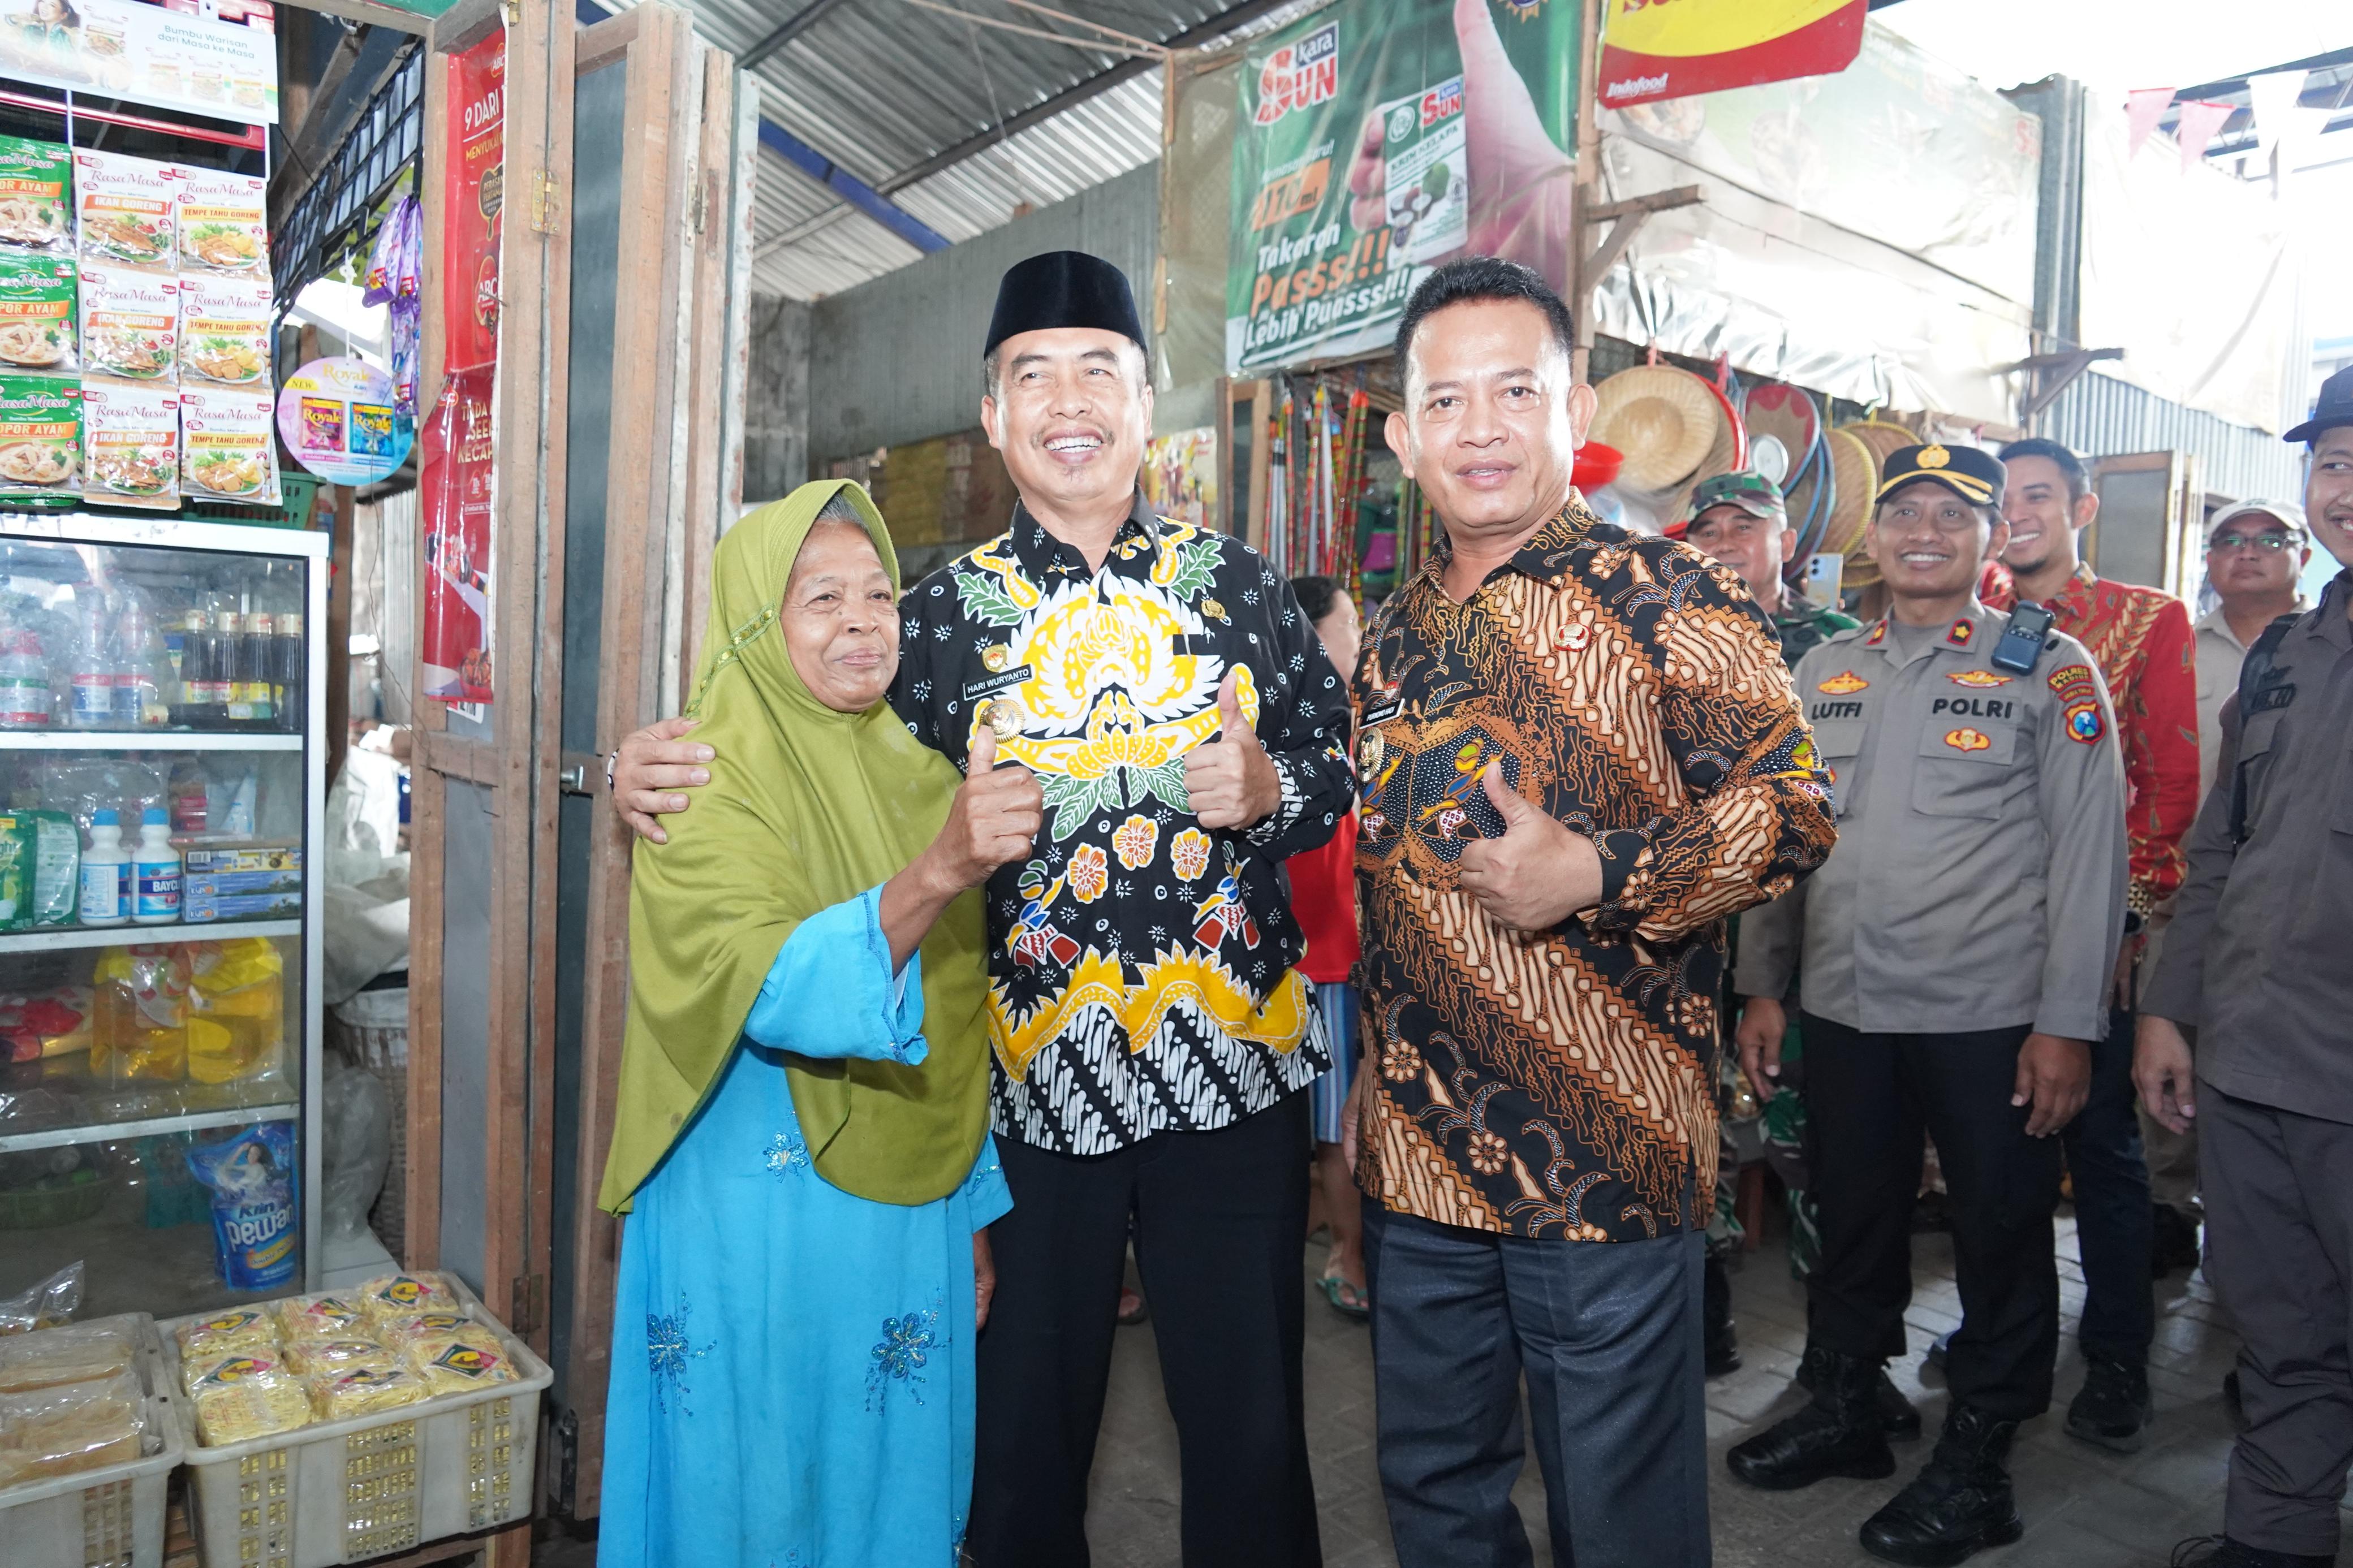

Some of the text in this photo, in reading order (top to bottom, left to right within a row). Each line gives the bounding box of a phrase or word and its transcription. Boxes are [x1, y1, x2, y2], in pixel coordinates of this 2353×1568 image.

[158, 33, 179, 44] dari
[182, 38, 210, 50] Masa
[227, 48, 255, 59] Masa
[165, 25, 248, 49] Bumbu Warisan
[1298, 31, 1335, 62] kara
[492, 54, 505, 72] ABC
[1606, 72, 1669, 98] Indofood
[464, 106, 472, 131] 9
[475, 88, 499, 128] DARI
[19, 181, 52, 193] AYAM
[94, 196, 119, 207] IKAN
[122, 198, 163, 211] GORENG
[1258, 223, 1341, 272] Takaran
[477, 277, 498, 303] ABC
[27, 304, 59, 314] AYAM
[98, 313, 165, 327] IKAN GORENG
[190, 321, 213, 330] TEMPE
[216, 322, 234, 331] TAHU
[1246, 304, 1299, 350] Lebih
[291, 380, 312, 389] NEW
[462, 401, 488, 421] TIDA
[35, 425, 66, 435] AYAM
[100, 433, 166, 443] IKAN GORENG
[967, 668, 1029, 694] HARI WURYANTO
[2049, 667, 2089, 686] POLRES
[1812, 702, 1863, 720] LUTFI
[1932, 698, 2013, 719] POLRI
